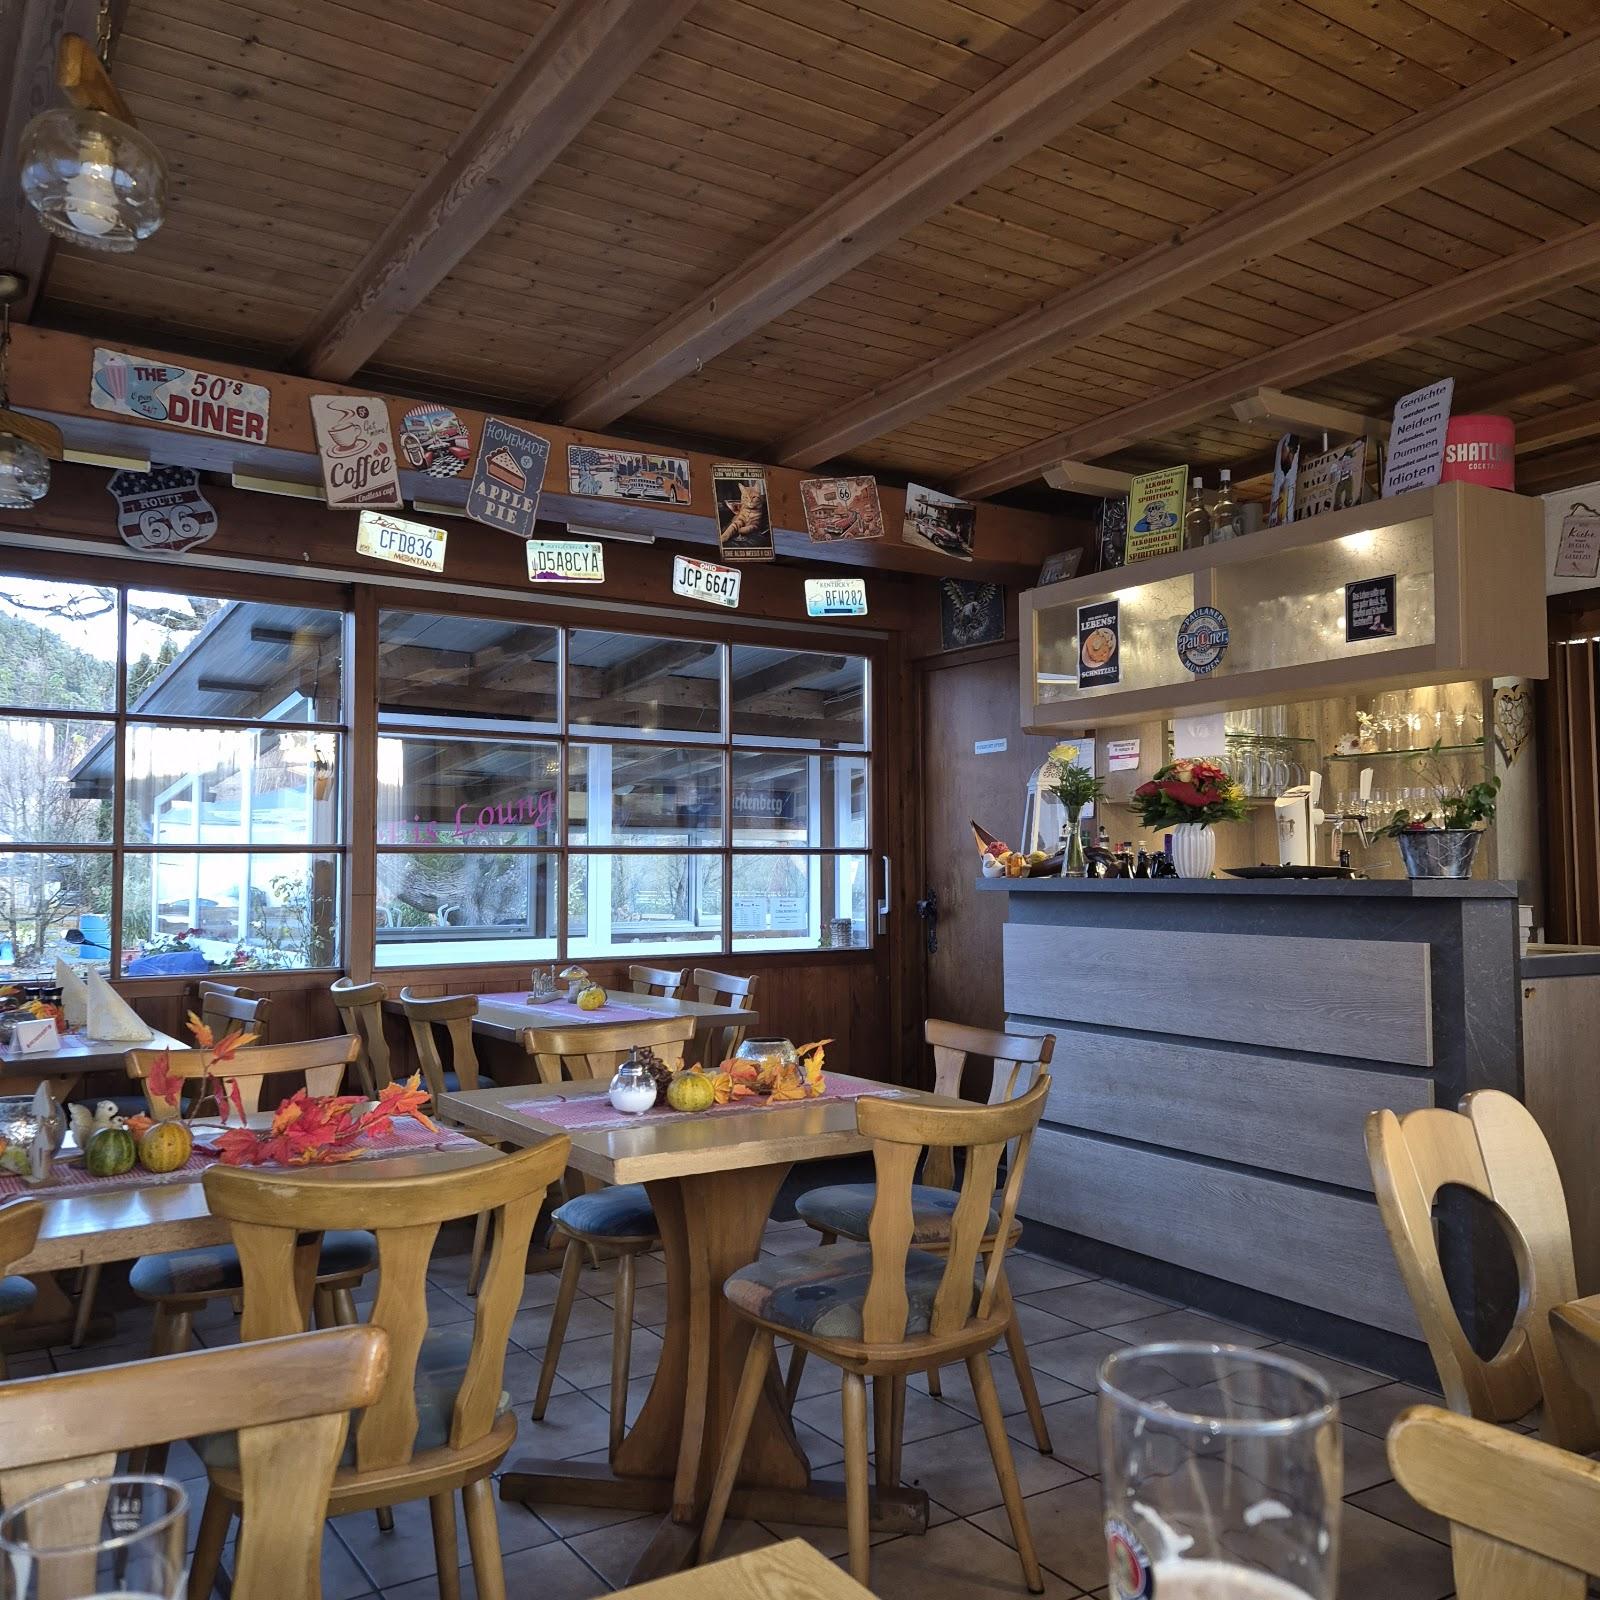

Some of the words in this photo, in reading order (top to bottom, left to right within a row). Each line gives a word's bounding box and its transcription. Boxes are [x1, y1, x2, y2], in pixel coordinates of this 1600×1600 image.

[134, 366, 168, 382] THE
[191, 373, 243, 401] 50's
[1400, 386, 1446, 409] Gerüchte
[168, 394, 264, 440] DINER
[1403, 406, 1426, 419] werden
[1427, 402, 1440, 410] von
[1397, 412, 1441, 435] Neidern
[1425, 427, 1437, 435] von
[486, 424, 546, 457] HOMEMADE
[1393, 439, 1438, 460] Dummen
[607, 453, 627, 463] NEW
[1416, 454, 1428, 464] und
[1428, 450, 1439, 459] von
[330, 454, 392, 490] Coffee
[1389, 464, 1435, 487] Idioten
[382, 486, 395, 497] cup
[839, 488, 849, 498] 66
[1144, 478, 1174, 489] ALKOHOL
[139, 494, 184, 509] ROUTE
[475, 481, 534, 513] APPLE
[484, 500, 518, 524] PIE
[139, 504, 200, 544] 66
[380, 529, 433, 559] CFD836
[393, 552, 437, 568] MONTANA
[538, 551, 599, 572] D5A8CYA
[700, 563, 717, 571] OHIO
[679, 567, 702, 588] JCP
[706, 573, 736, 597] 6647
[825, 590, 863, 606] BFW282
[1081, 615, 1116, 631] LEBENS?
[1184, 608, 1223, 627] PAULANER
[1081, 665, 1117, 679] SCHNITZEL!
[452, 789, 556, 838] Loung
